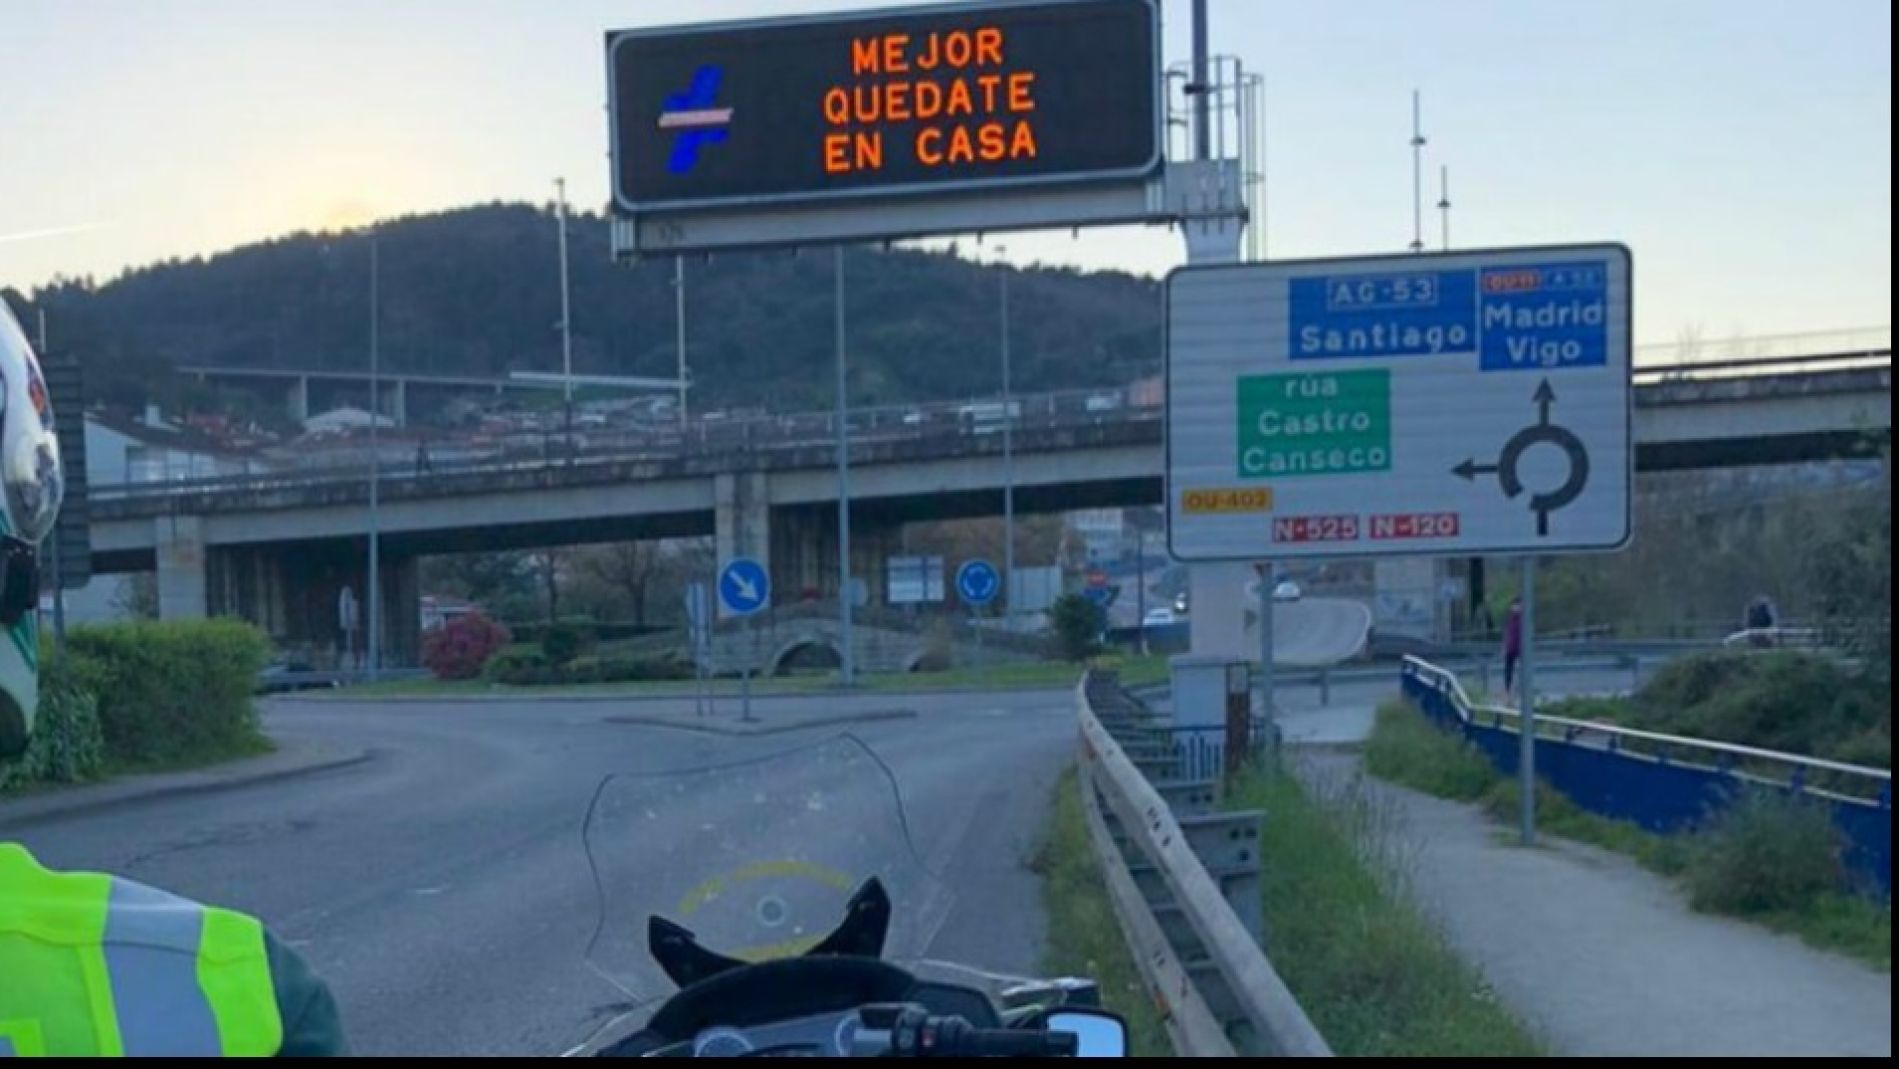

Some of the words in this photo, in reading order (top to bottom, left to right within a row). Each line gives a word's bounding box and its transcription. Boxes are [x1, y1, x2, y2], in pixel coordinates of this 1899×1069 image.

[852, 27, 1003, 75] MEJOR
[823, 72, 1036, 125] QUEDATE
[824, 131, 883, 173] EN
[915, 120, 1037, 165] CASA
[1335, 280, 1433, 303] AG-53
[1484, 301, 1603, 329] Madrid
[1301, 323, 1467, 353] Santiago
[1506, 336, 1581, 365] Vigo
[1285, 372, 1338, 398] rúa
[1257, 407, 1371, 436] Castro
[1242, 447, 1387, 472] Canseco
[1275, 519, 1357, 540] N-525
[1375, 516, 1456, 537] N-120
